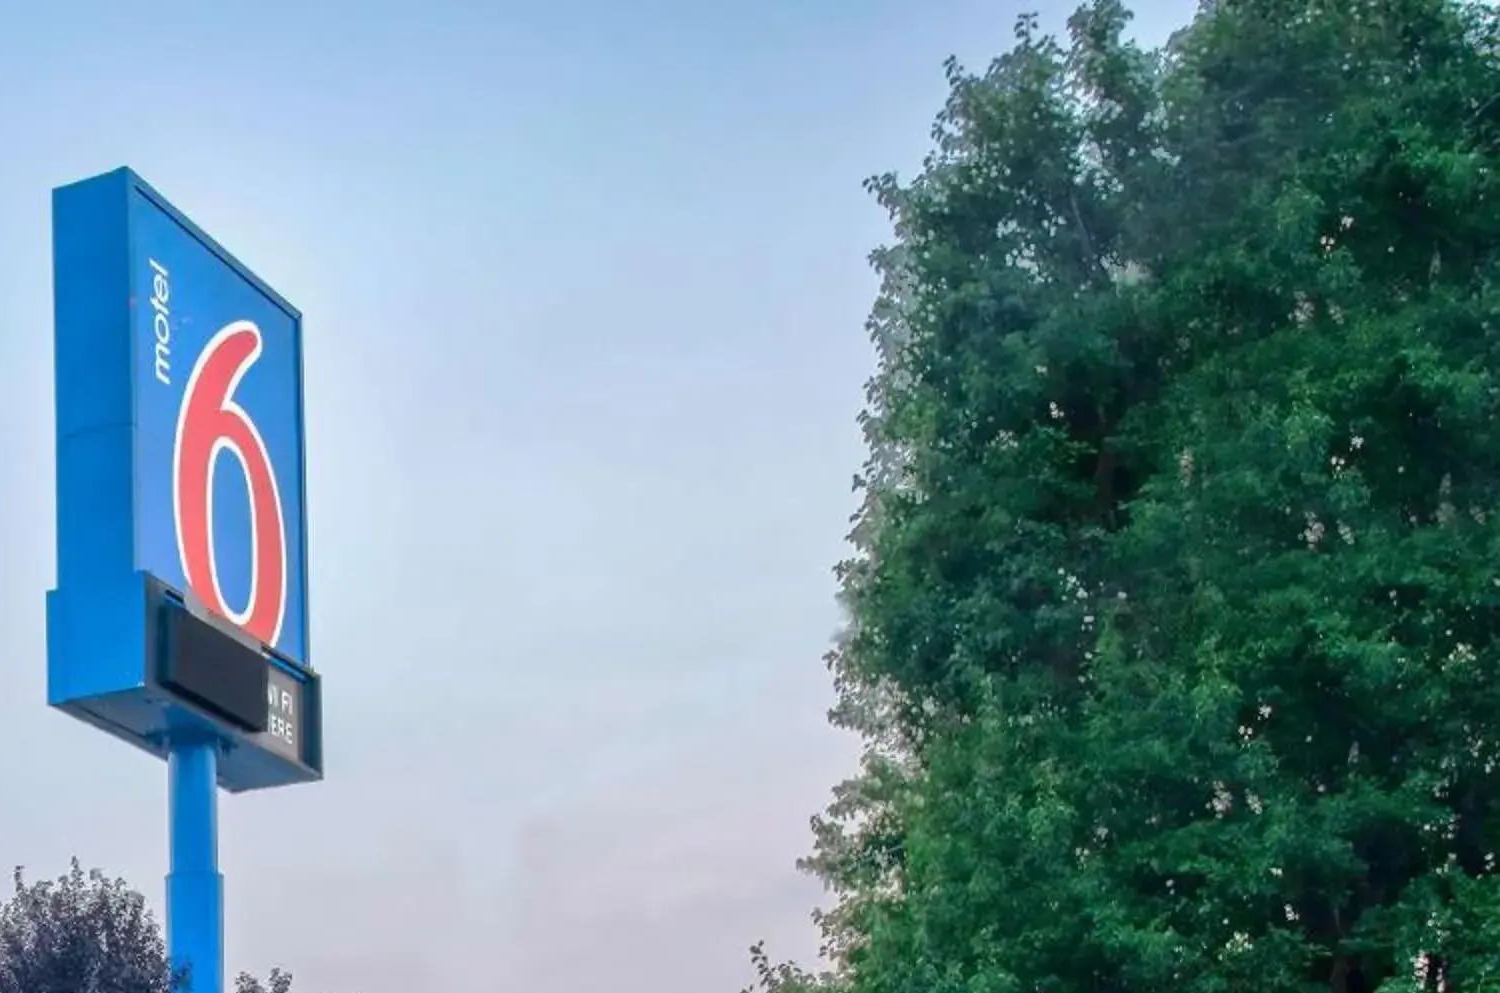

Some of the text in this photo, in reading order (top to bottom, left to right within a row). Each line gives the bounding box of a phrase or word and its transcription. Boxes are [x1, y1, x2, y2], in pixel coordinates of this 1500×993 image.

[149, 257, 171, 385] motel
[172, 319, 287, 658] 6
[269, 714, 293, 745] ERE
